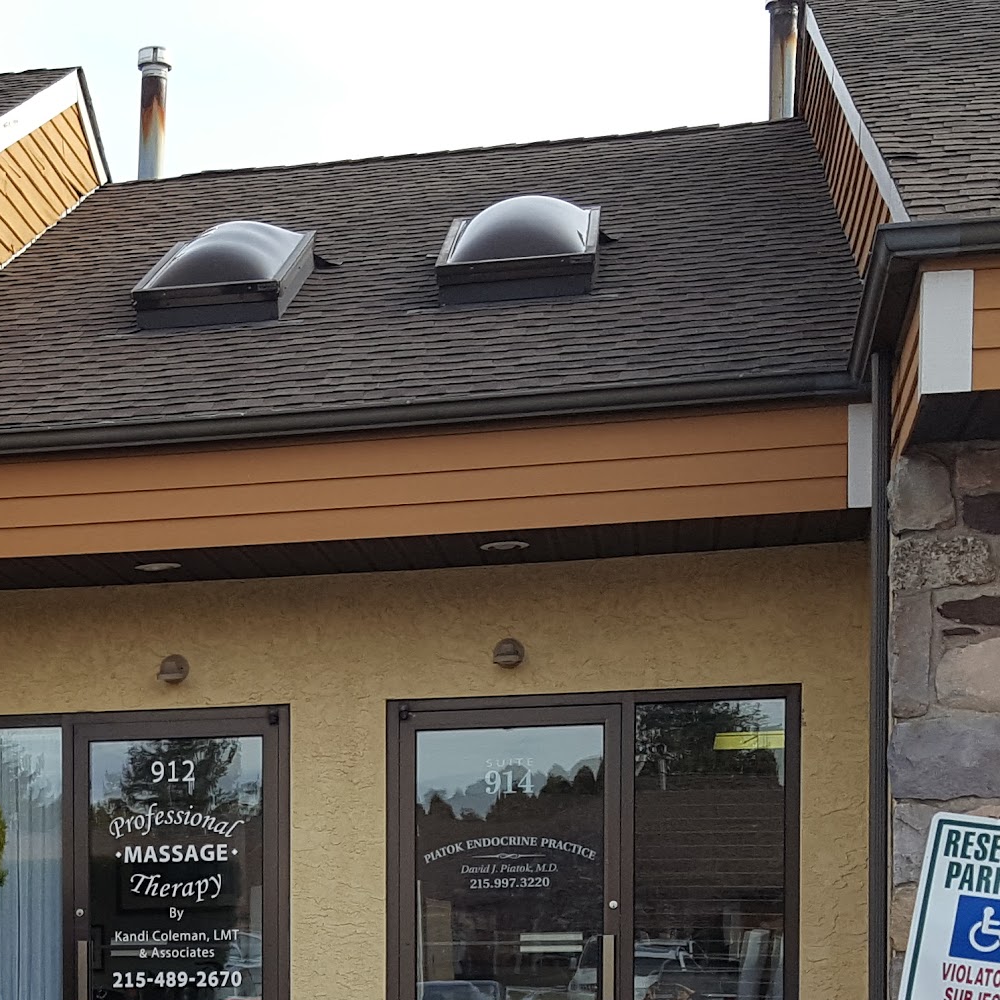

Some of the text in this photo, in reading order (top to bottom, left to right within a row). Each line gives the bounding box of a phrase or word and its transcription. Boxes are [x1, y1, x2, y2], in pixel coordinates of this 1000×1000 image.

[151, 760, 195, 783] 912
[485, 757, 534, 768] SUITE
[484, 769, 535, 795] 914
[109, 803, 244, 839] Professional
[124, 844, 228, 863] MASSAGE
[424, 836, 597, 864] PIATOK ENDOCRINE PRACTICE
[943, 829, 1000, 863] RESE
[461, 864, 489, 874] David
[491, 864, 499, 875] J.
[535, 863, 559, 873] M.D.
[130, 873, 222, 902] Therapy
[469, 877, 550, 889] 215.997.3220
[169, 907, 184, 920] By
[114, 929, 239, 942] Kandi Coleman, LMT
[138, 947, 215, 959] & Associates
[112, 971, 242, 988] 215-489-2670
